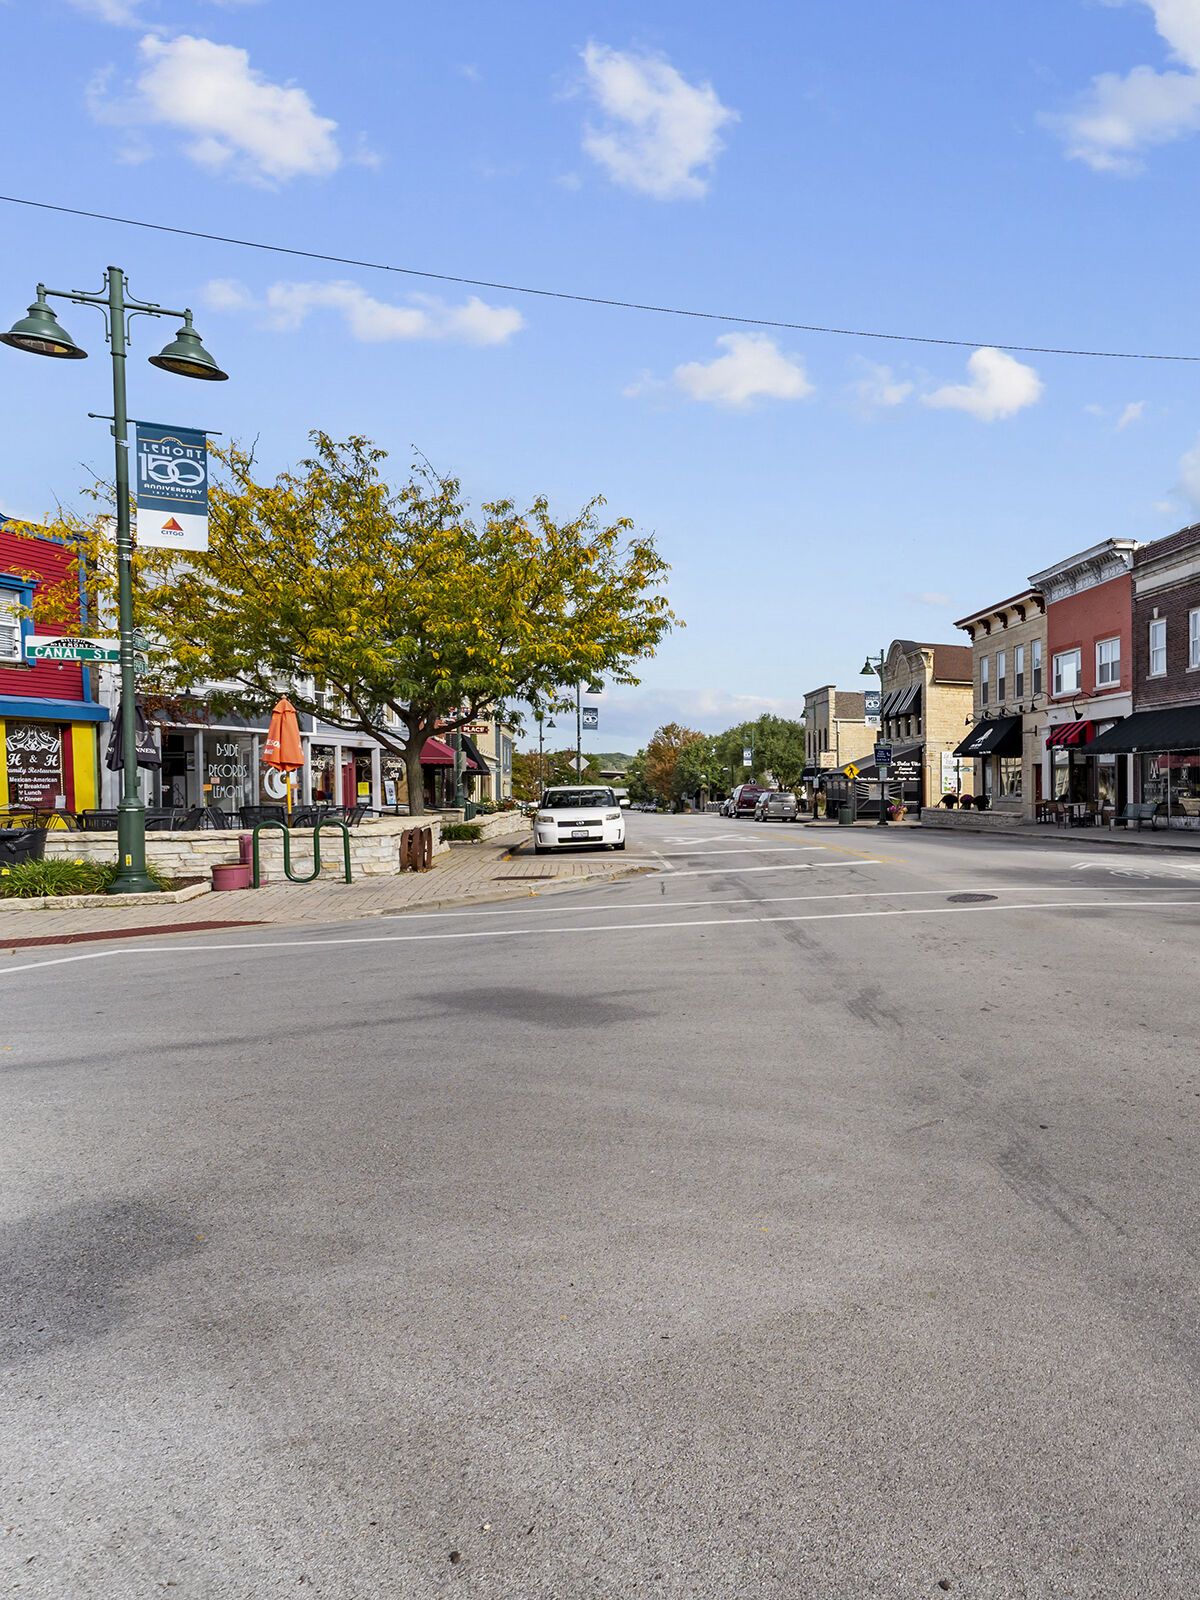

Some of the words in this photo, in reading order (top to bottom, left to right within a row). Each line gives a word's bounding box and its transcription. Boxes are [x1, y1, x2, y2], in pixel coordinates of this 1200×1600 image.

[143, 443, 202, 459] LEMONT
[138, 452, 205, 487] 150
[144, 483, 203, 495] ANNIVERSARY
[35, 647, 78, 659] CANAL
[93, 650, 111, 660] ST
[216, 743, 239, 757] B-SIDE
[6, 753, 22, 766] H
[29, 754, 38, 763] &
[43, 754, 59, 767] H
[7, 767, 27, 775] amily
[208, 764, 248, 778] RECORDS
[213, 785, 243, 799] LEMONT
